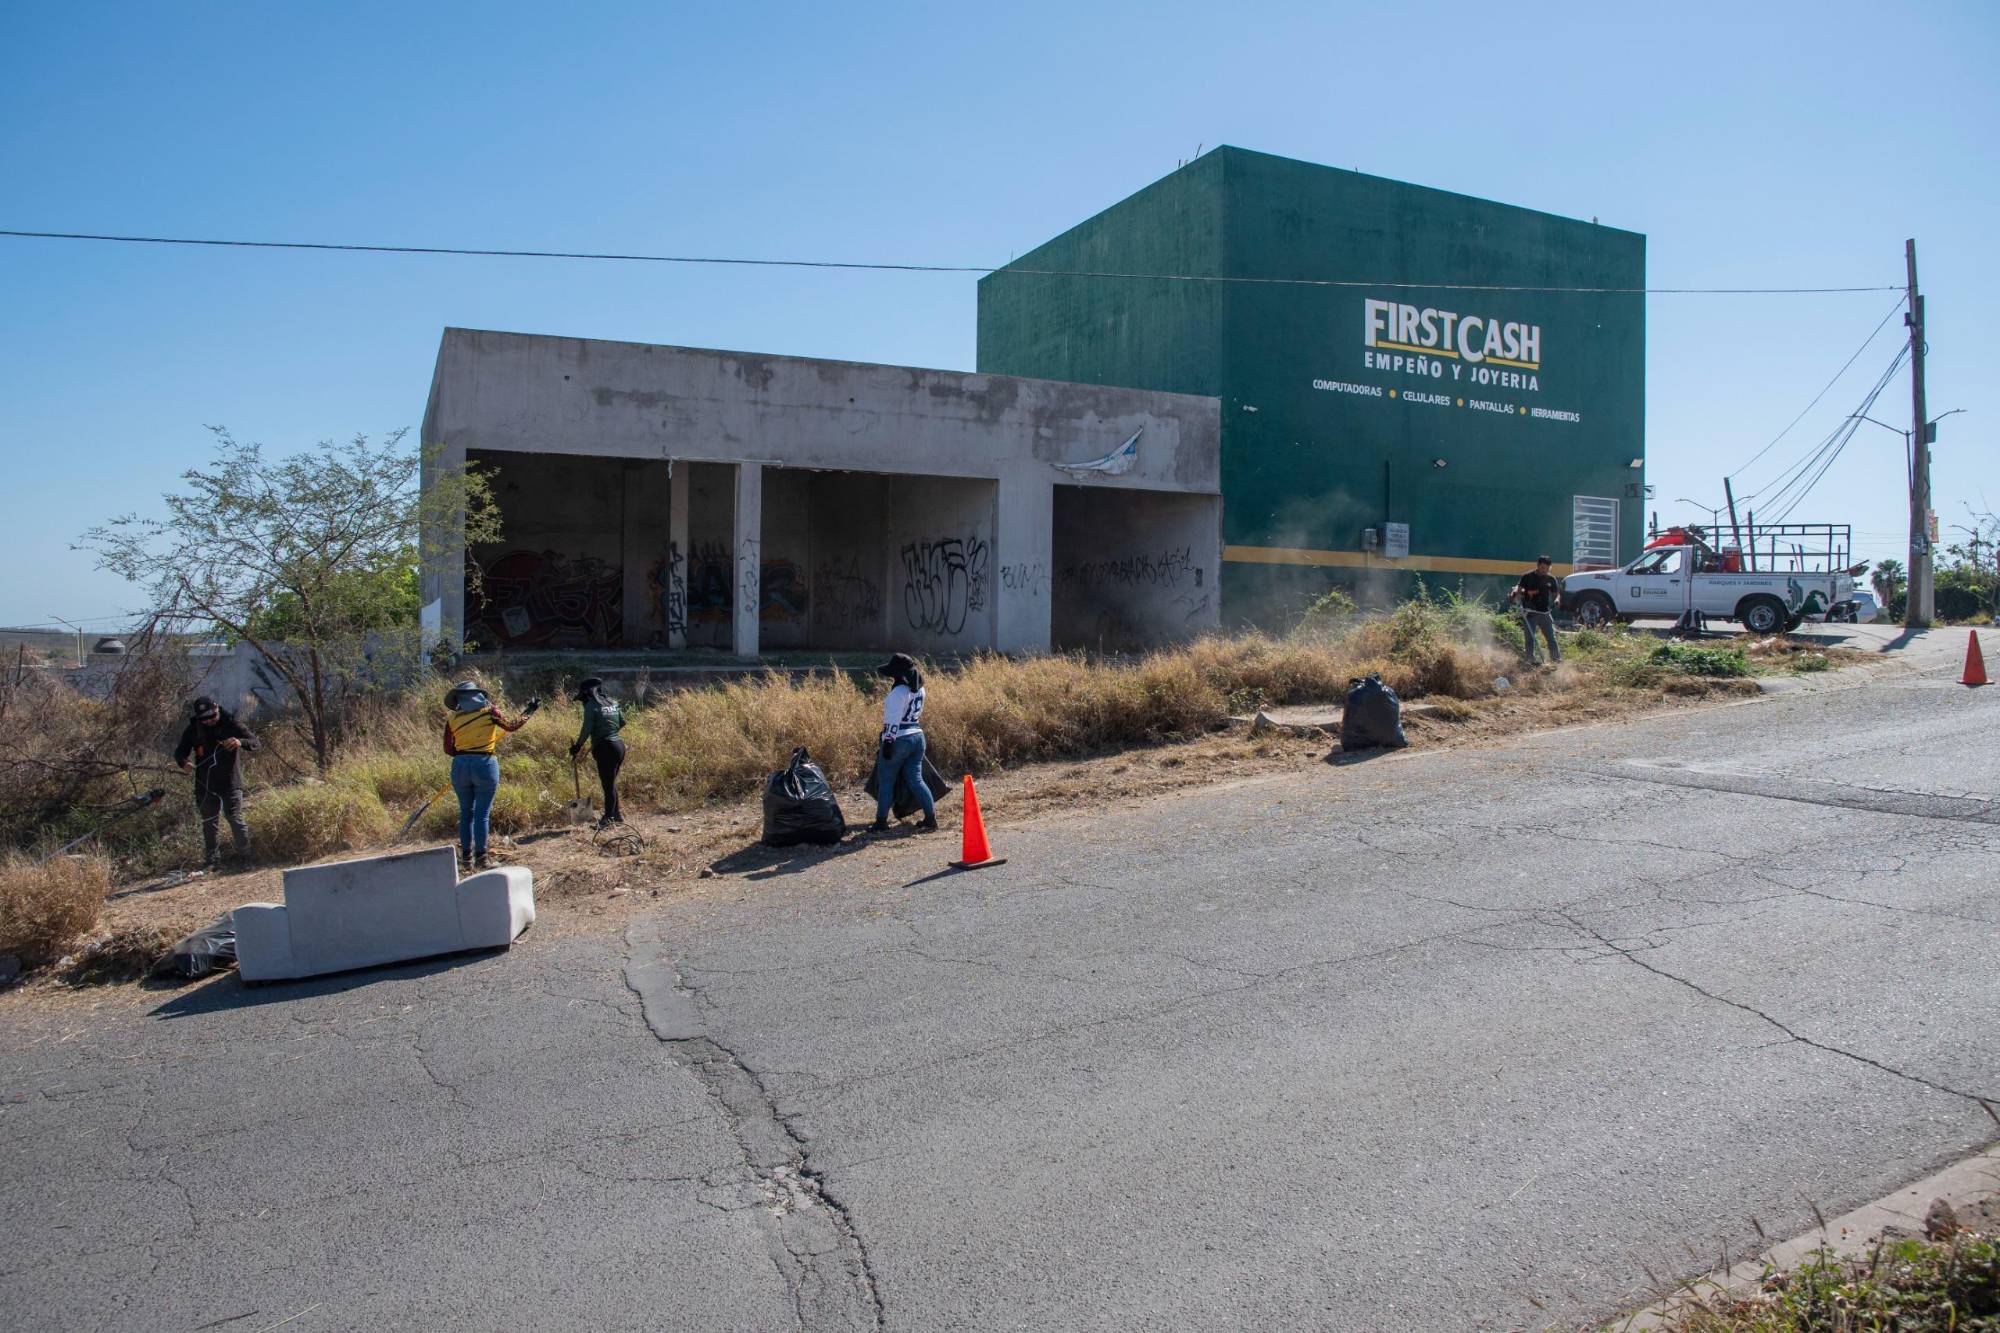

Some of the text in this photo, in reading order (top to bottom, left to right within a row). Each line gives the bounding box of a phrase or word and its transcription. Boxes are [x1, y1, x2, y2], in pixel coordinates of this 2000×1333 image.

[1364, 298, 1540, 363] FIRSTCASH
[1364, 351, 1540, 392] EMPEÑO Y JOYERIA
[1312, 379, 1581, 423] COMPUTADORAS CELULARES PANTALLAS HERRAMIENTAS
